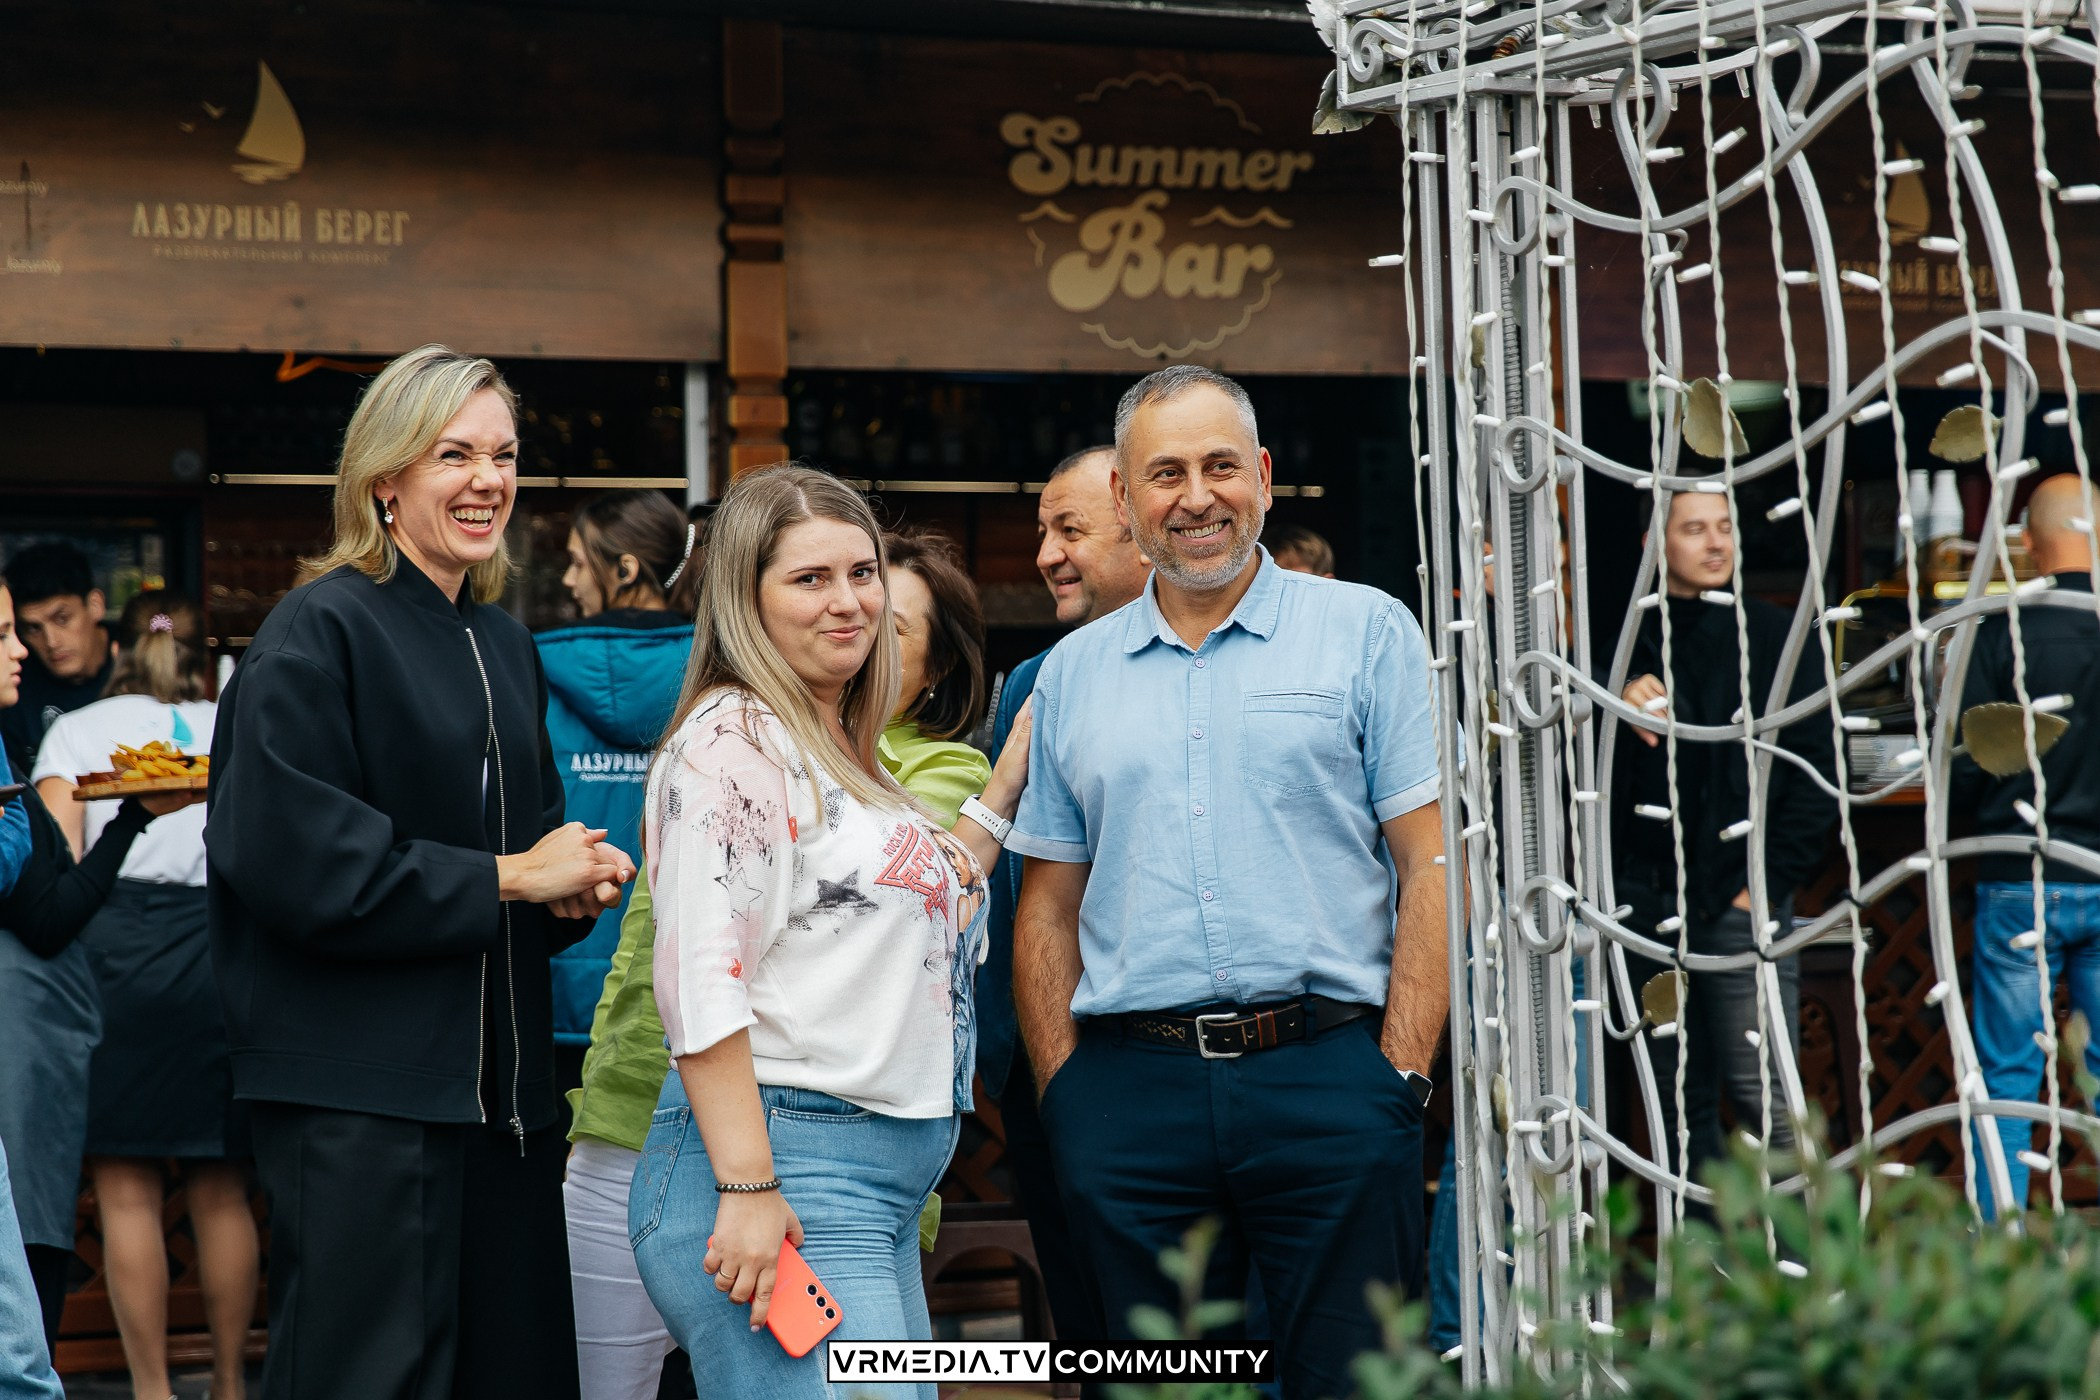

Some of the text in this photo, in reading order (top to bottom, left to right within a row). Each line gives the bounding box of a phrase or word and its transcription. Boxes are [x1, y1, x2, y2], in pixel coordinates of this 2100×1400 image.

[999, 112, 1315, 196] Summer
[131, 200, 411, 246] ЛАЗУРНЫЙ БЕРЕГ
[1047, 190, 1275, 313] Bar
